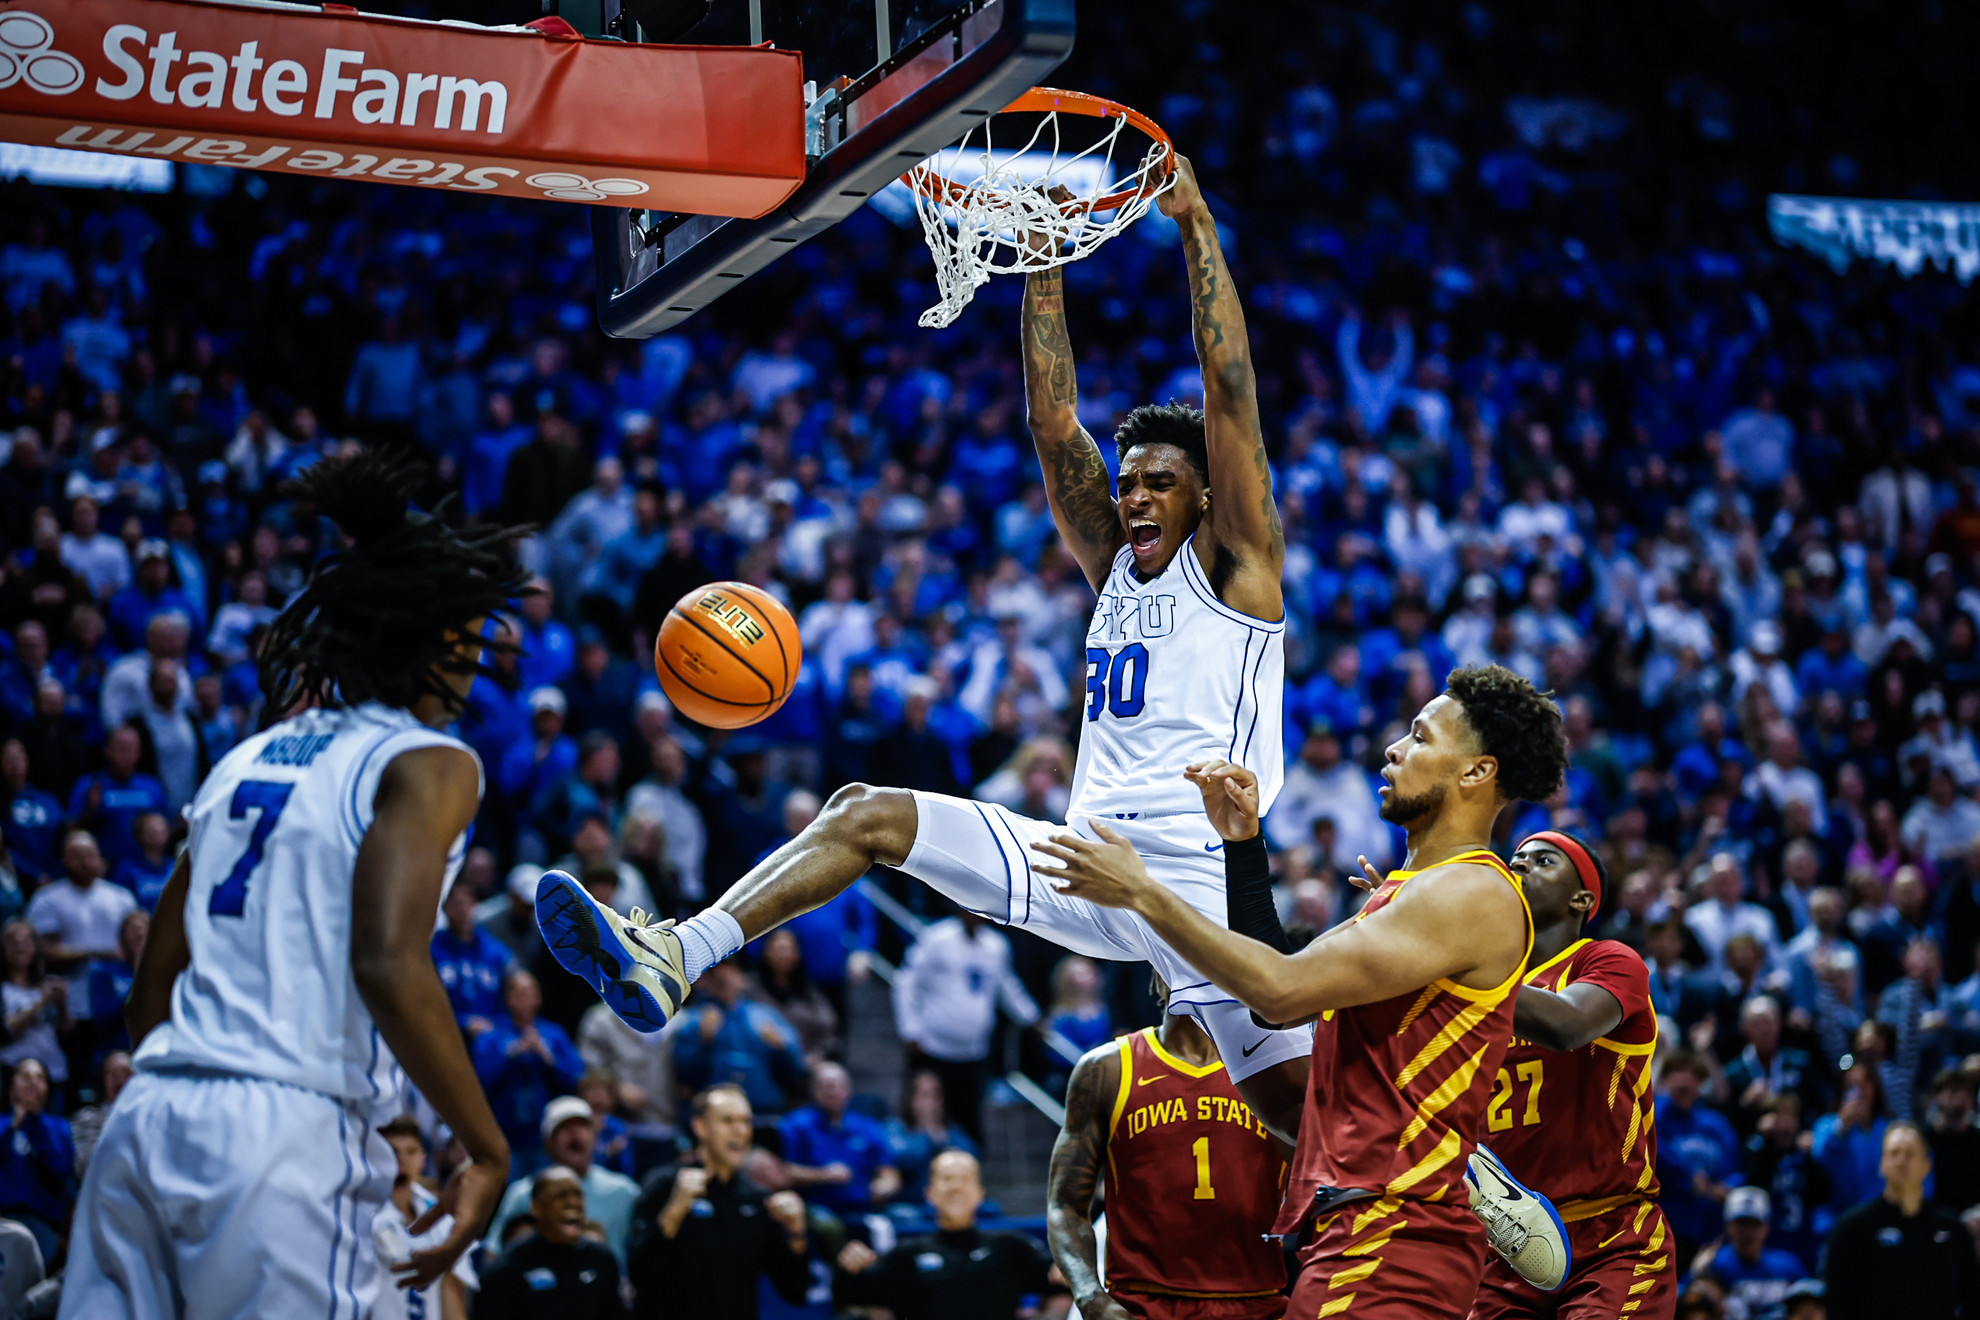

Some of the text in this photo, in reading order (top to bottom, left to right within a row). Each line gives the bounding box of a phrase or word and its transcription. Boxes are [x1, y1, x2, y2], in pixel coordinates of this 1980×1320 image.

[698, 592, 765, 645] ELITE
[1088, 594, 1176, 641] BYU
[1086, 642, 1149, 722] 30
[209, 779, 295, 917] 7
[1127, 1098, 1188, 1139] IOWA
[1487, 1059, 1544, 1133] 27
[1192, 1137, 1215, 1200] 1
